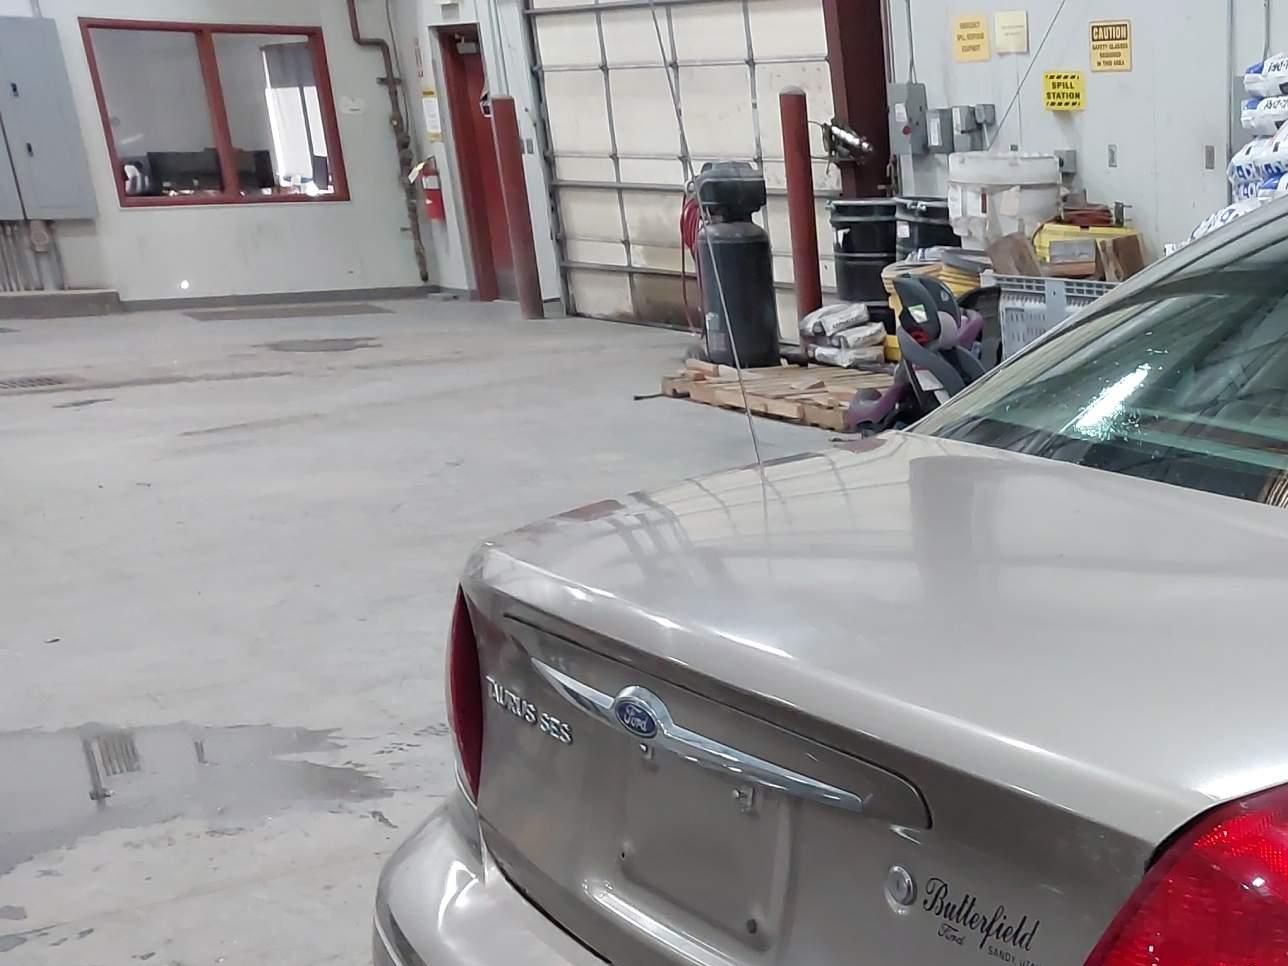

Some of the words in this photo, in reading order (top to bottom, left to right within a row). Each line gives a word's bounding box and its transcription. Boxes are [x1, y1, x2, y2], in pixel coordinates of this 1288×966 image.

[1093, 25, 1127, 40] CAUTION
[1046, 91, 1080, 100] STATION
[1051, 81, 1075, 89] SPILL
[486, 674, 537, 724] TAURUS
[540, 712, 573, 745] SES
[623, 704, 648, 732] Ford
[923, 877, 1040, 951] Butterfield
[938, 923, 967, 945] Ford
